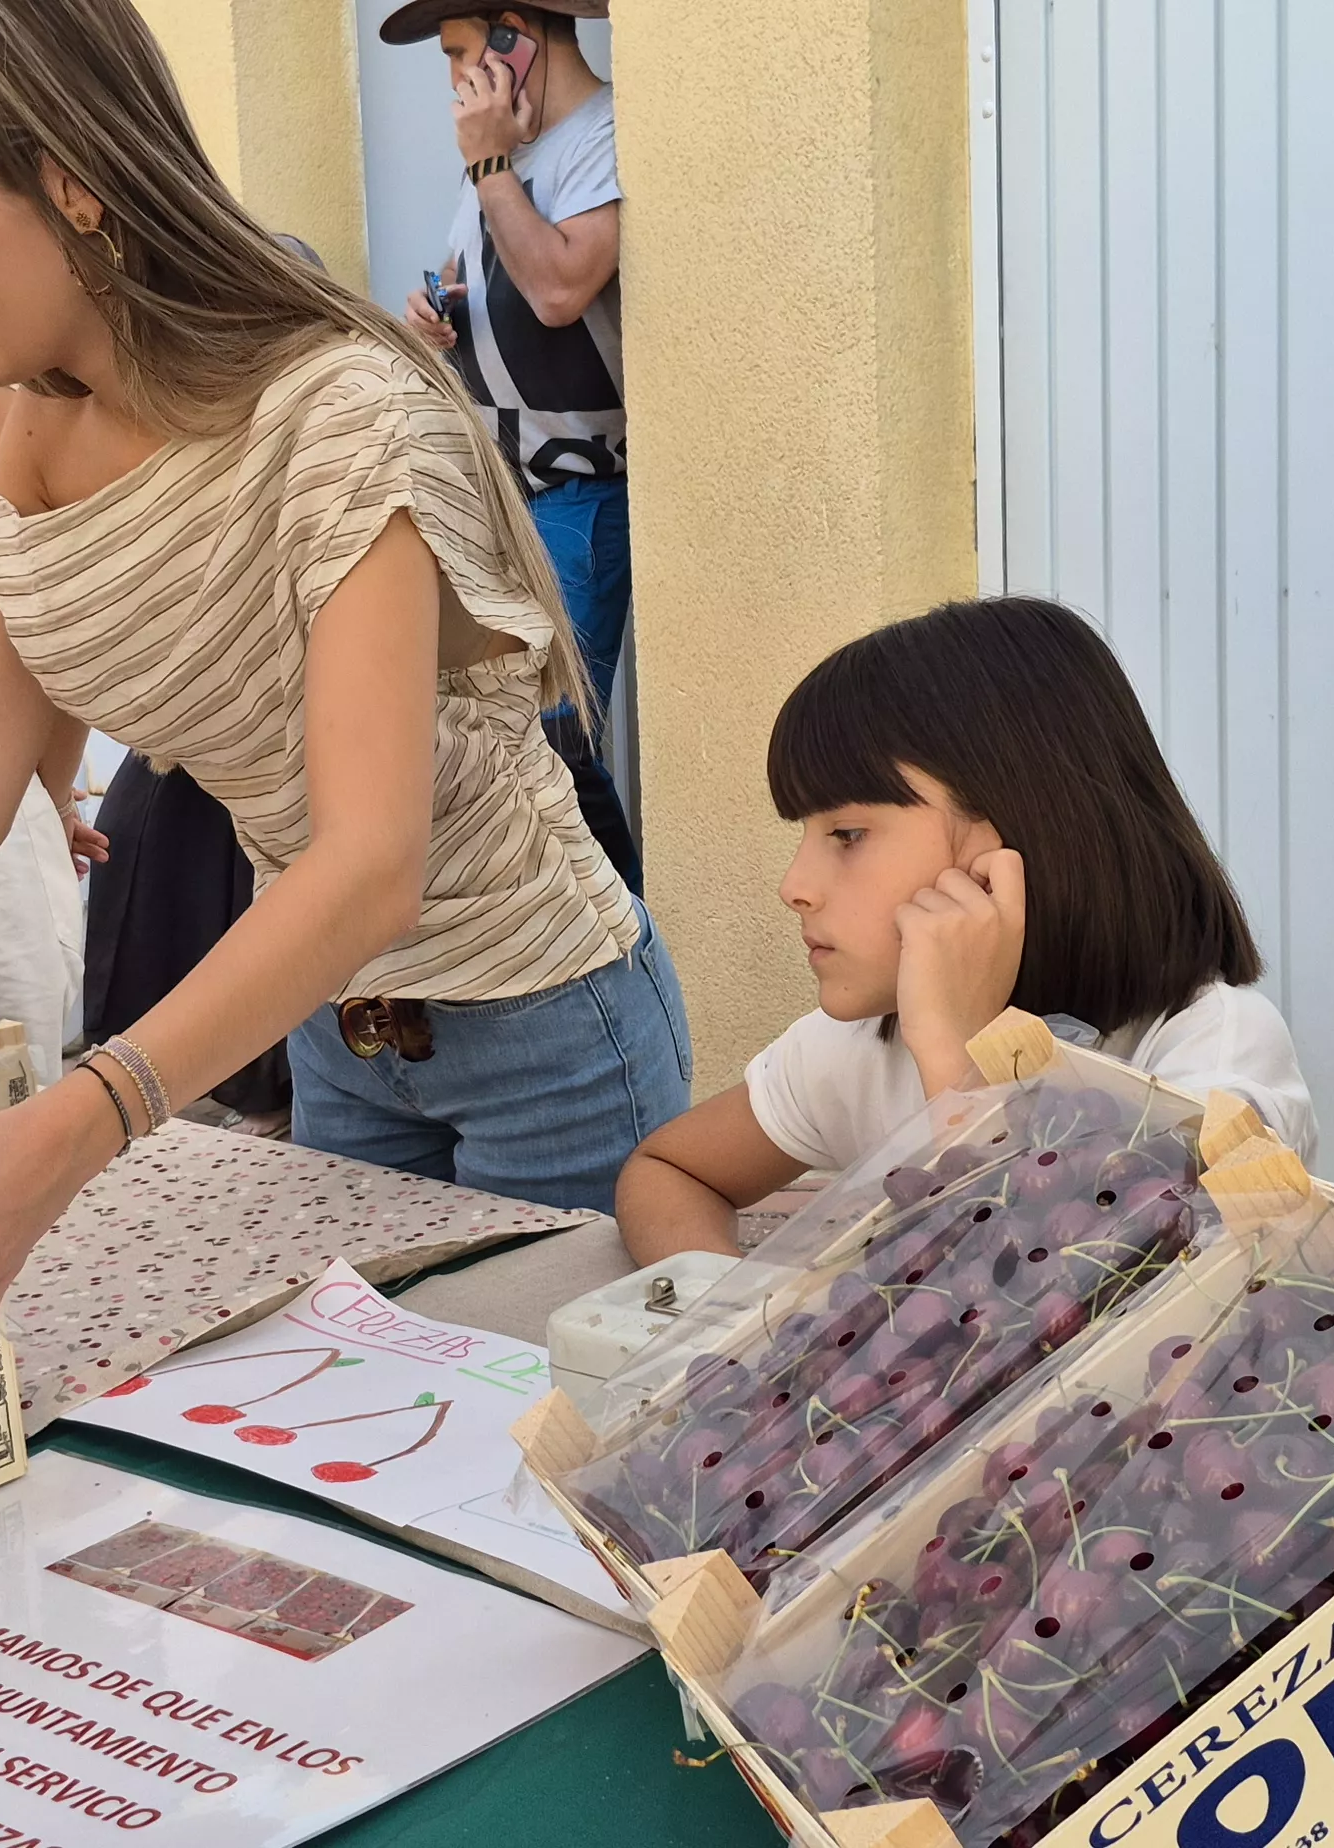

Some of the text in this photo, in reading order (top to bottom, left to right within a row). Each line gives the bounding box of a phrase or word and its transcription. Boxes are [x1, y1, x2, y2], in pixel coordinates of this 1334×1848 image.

[310, 1281, 486, 1358] CEREZAS
[88, 1670, 154, 1700] DE
[142, 1690, 234, 1730] QUE
[220, 1719, 289, 1751] EN
[276, 1739, 365, 1776] LOS
[1286, 1820, 1329, 1848] 38
